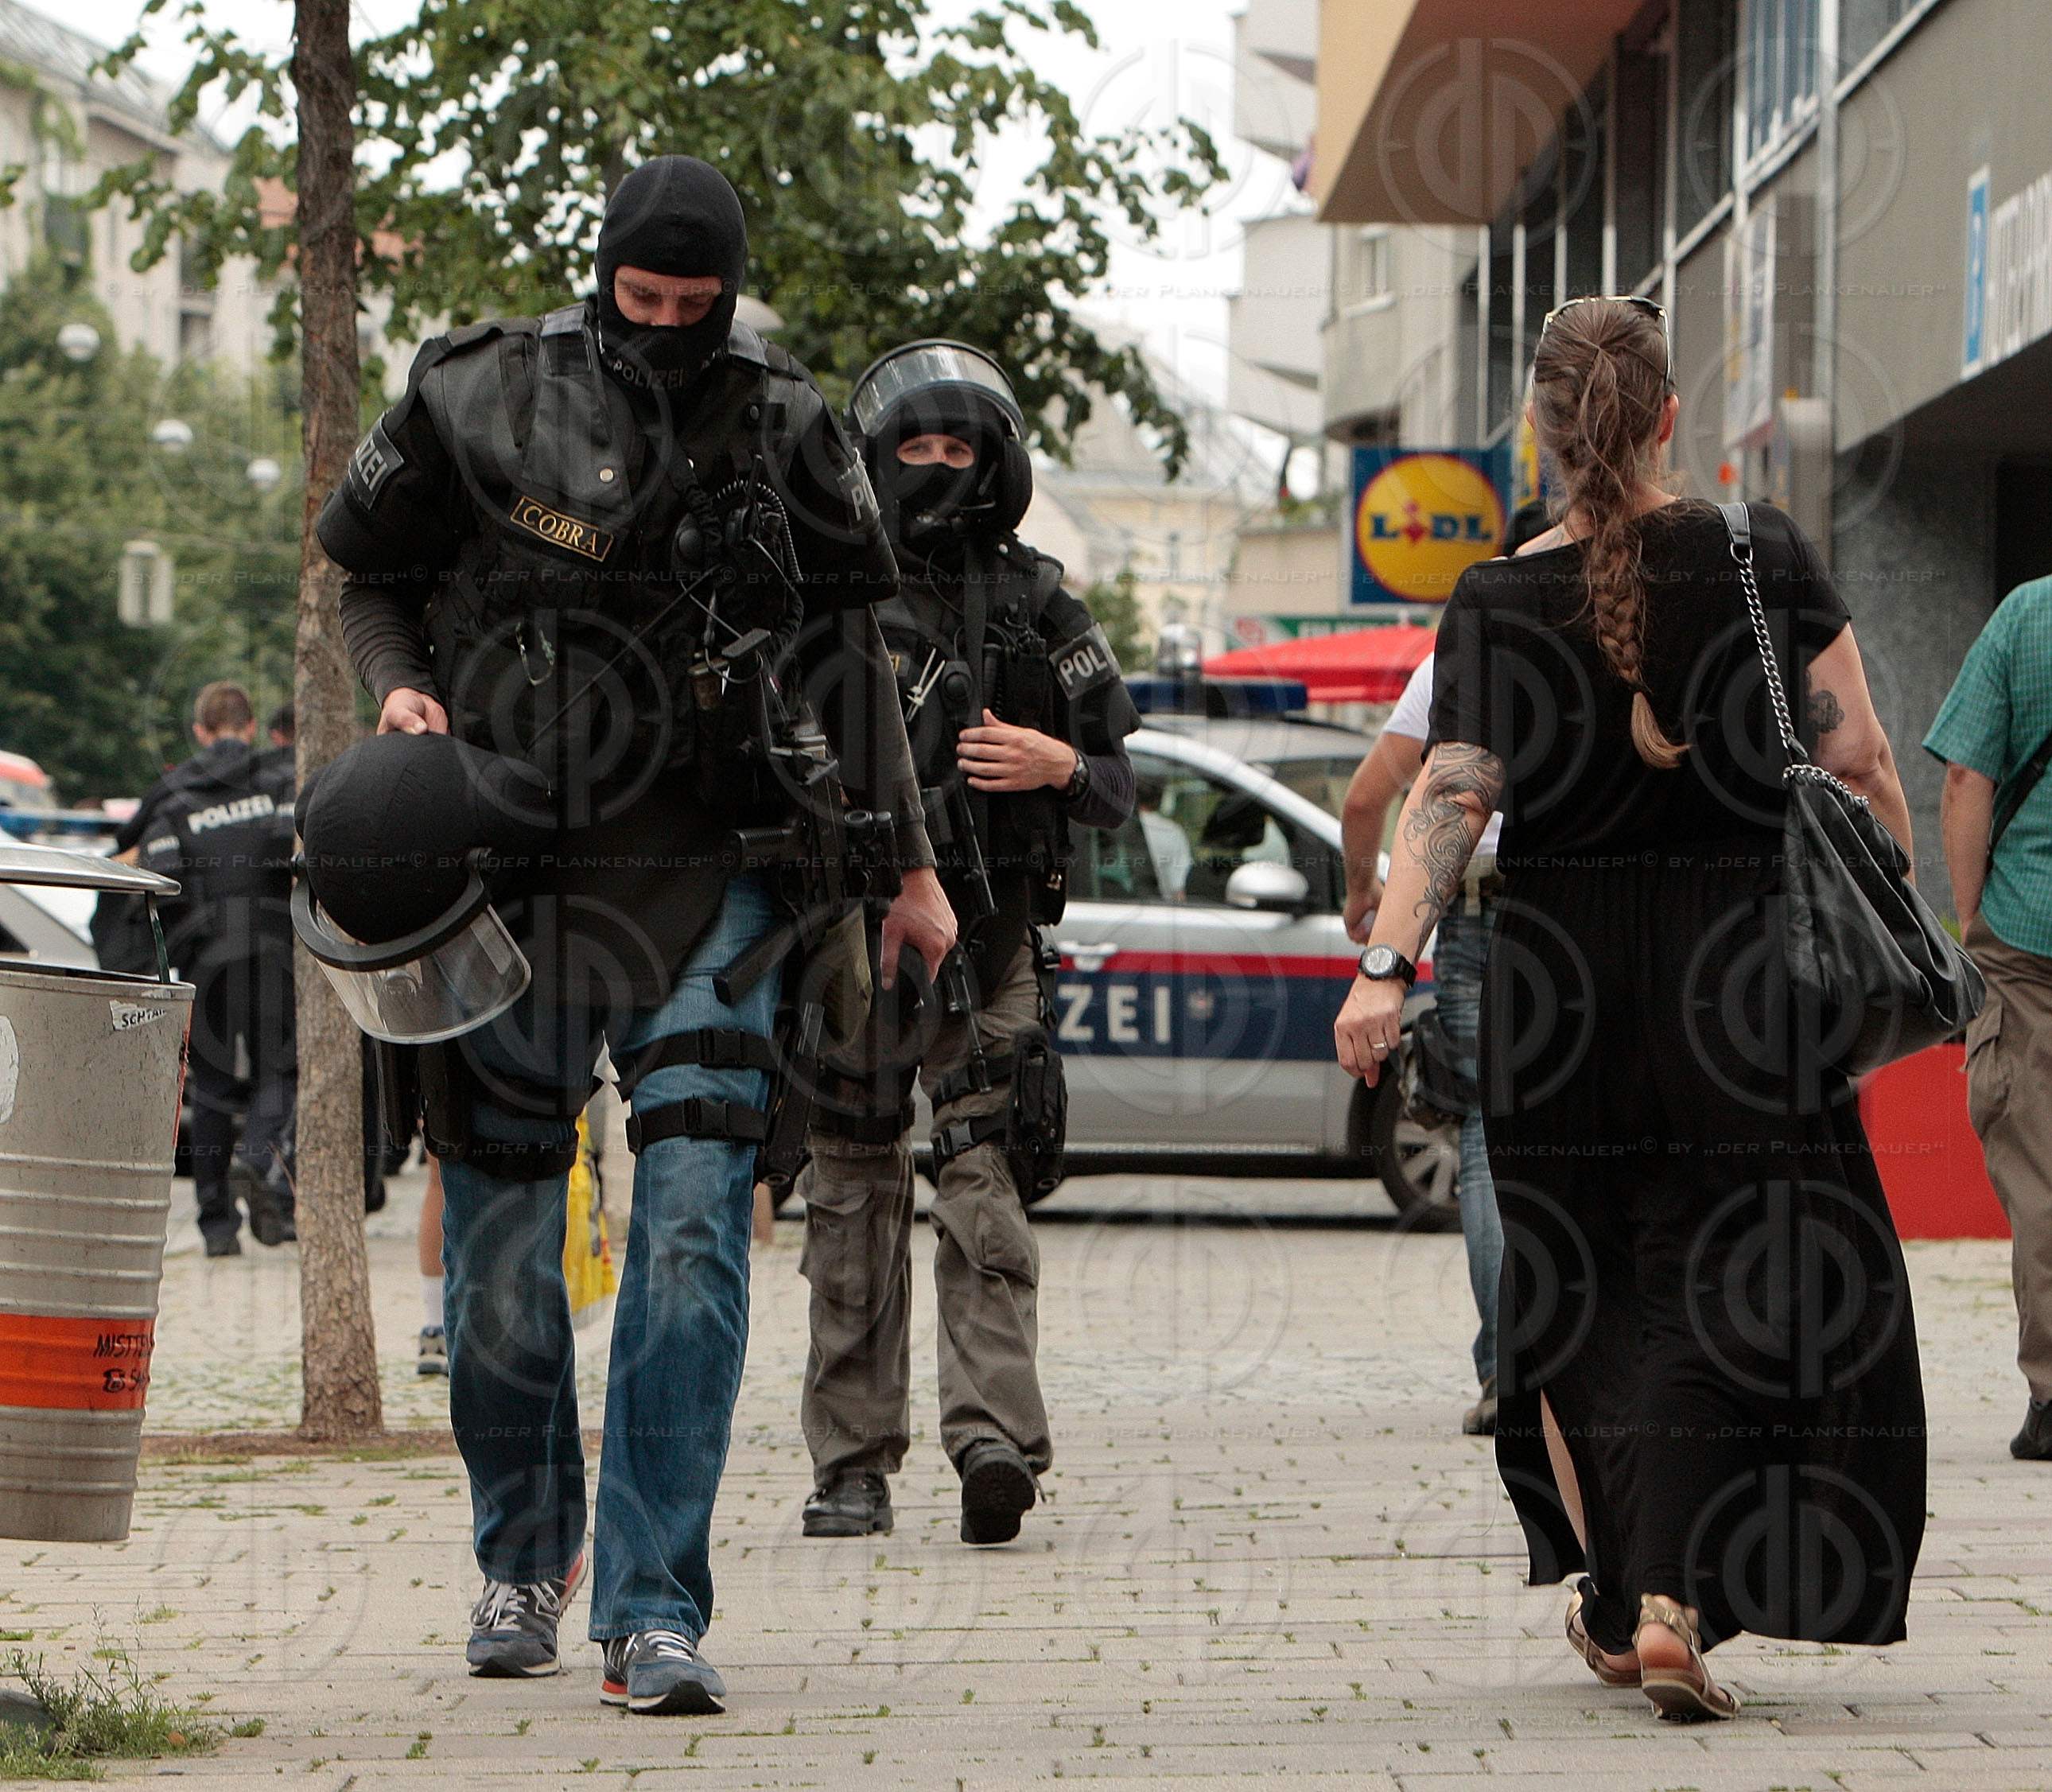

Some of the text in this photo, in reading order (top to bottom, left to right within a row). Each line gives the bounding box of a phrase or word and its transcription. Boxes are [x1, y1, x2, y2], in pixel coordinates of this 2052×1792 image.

[523, 505, 597, 554] COBRA
[1059, 645, 1108, 686] POL
[187, 794, 275, 834] POLIZEI
[1057, 984, 1172, 1044] ZEI
